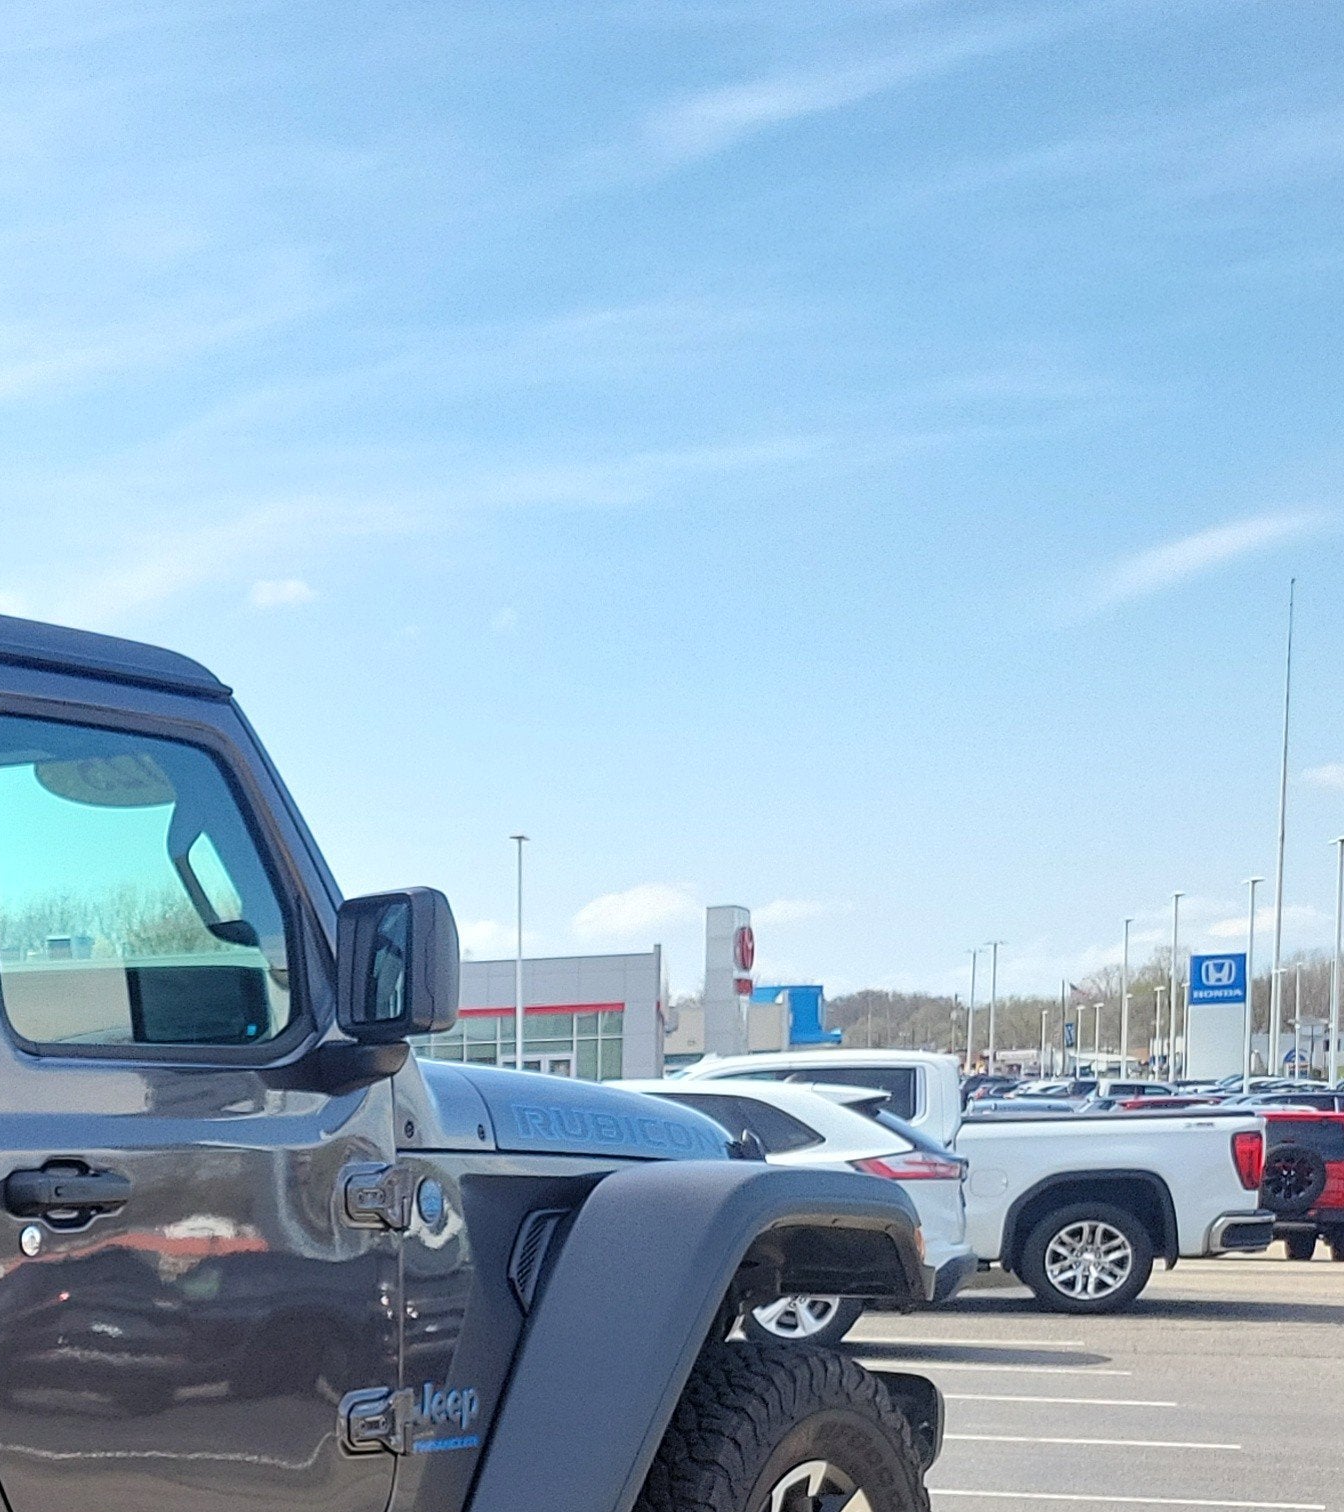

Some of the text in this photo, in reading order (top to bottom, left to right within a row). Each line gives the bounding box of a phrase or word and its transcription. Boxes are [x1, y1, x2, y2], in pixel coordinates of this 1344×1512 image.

[1192, 988, 1243, 999] HONDA
[512, 1103, 725, 1152] RUBICON
[413, 1382, 480, 1431] Jeep
